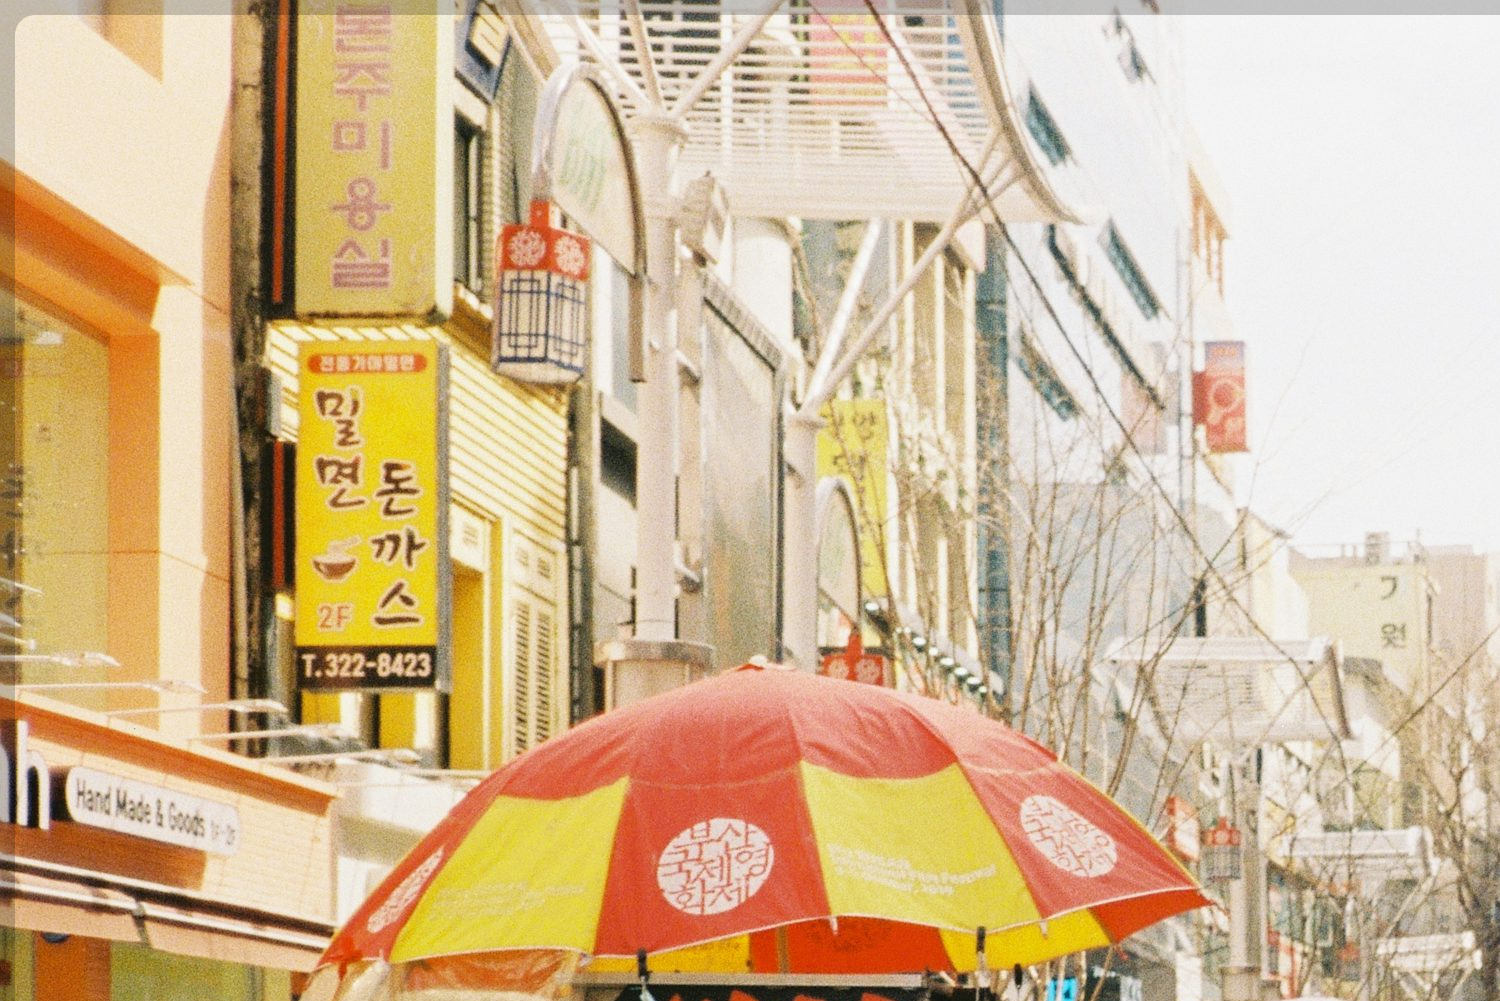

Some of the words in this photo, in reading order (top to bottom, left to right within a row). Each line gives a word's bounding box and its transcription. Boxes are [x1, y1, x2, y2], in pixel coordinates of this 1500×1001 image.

[315, 386, 366, 509] 밀면
[370, 462, 427, 626] 돈까스
[319, 604, 351, 630] 2F
[301, 652, 432, 678] T.322-8423
[75, 778, 112, 816] Hand
[115, 789, 152, 824] Made
[155, 798, 164, 828] &
[168, 802, 206, 837] Goods
